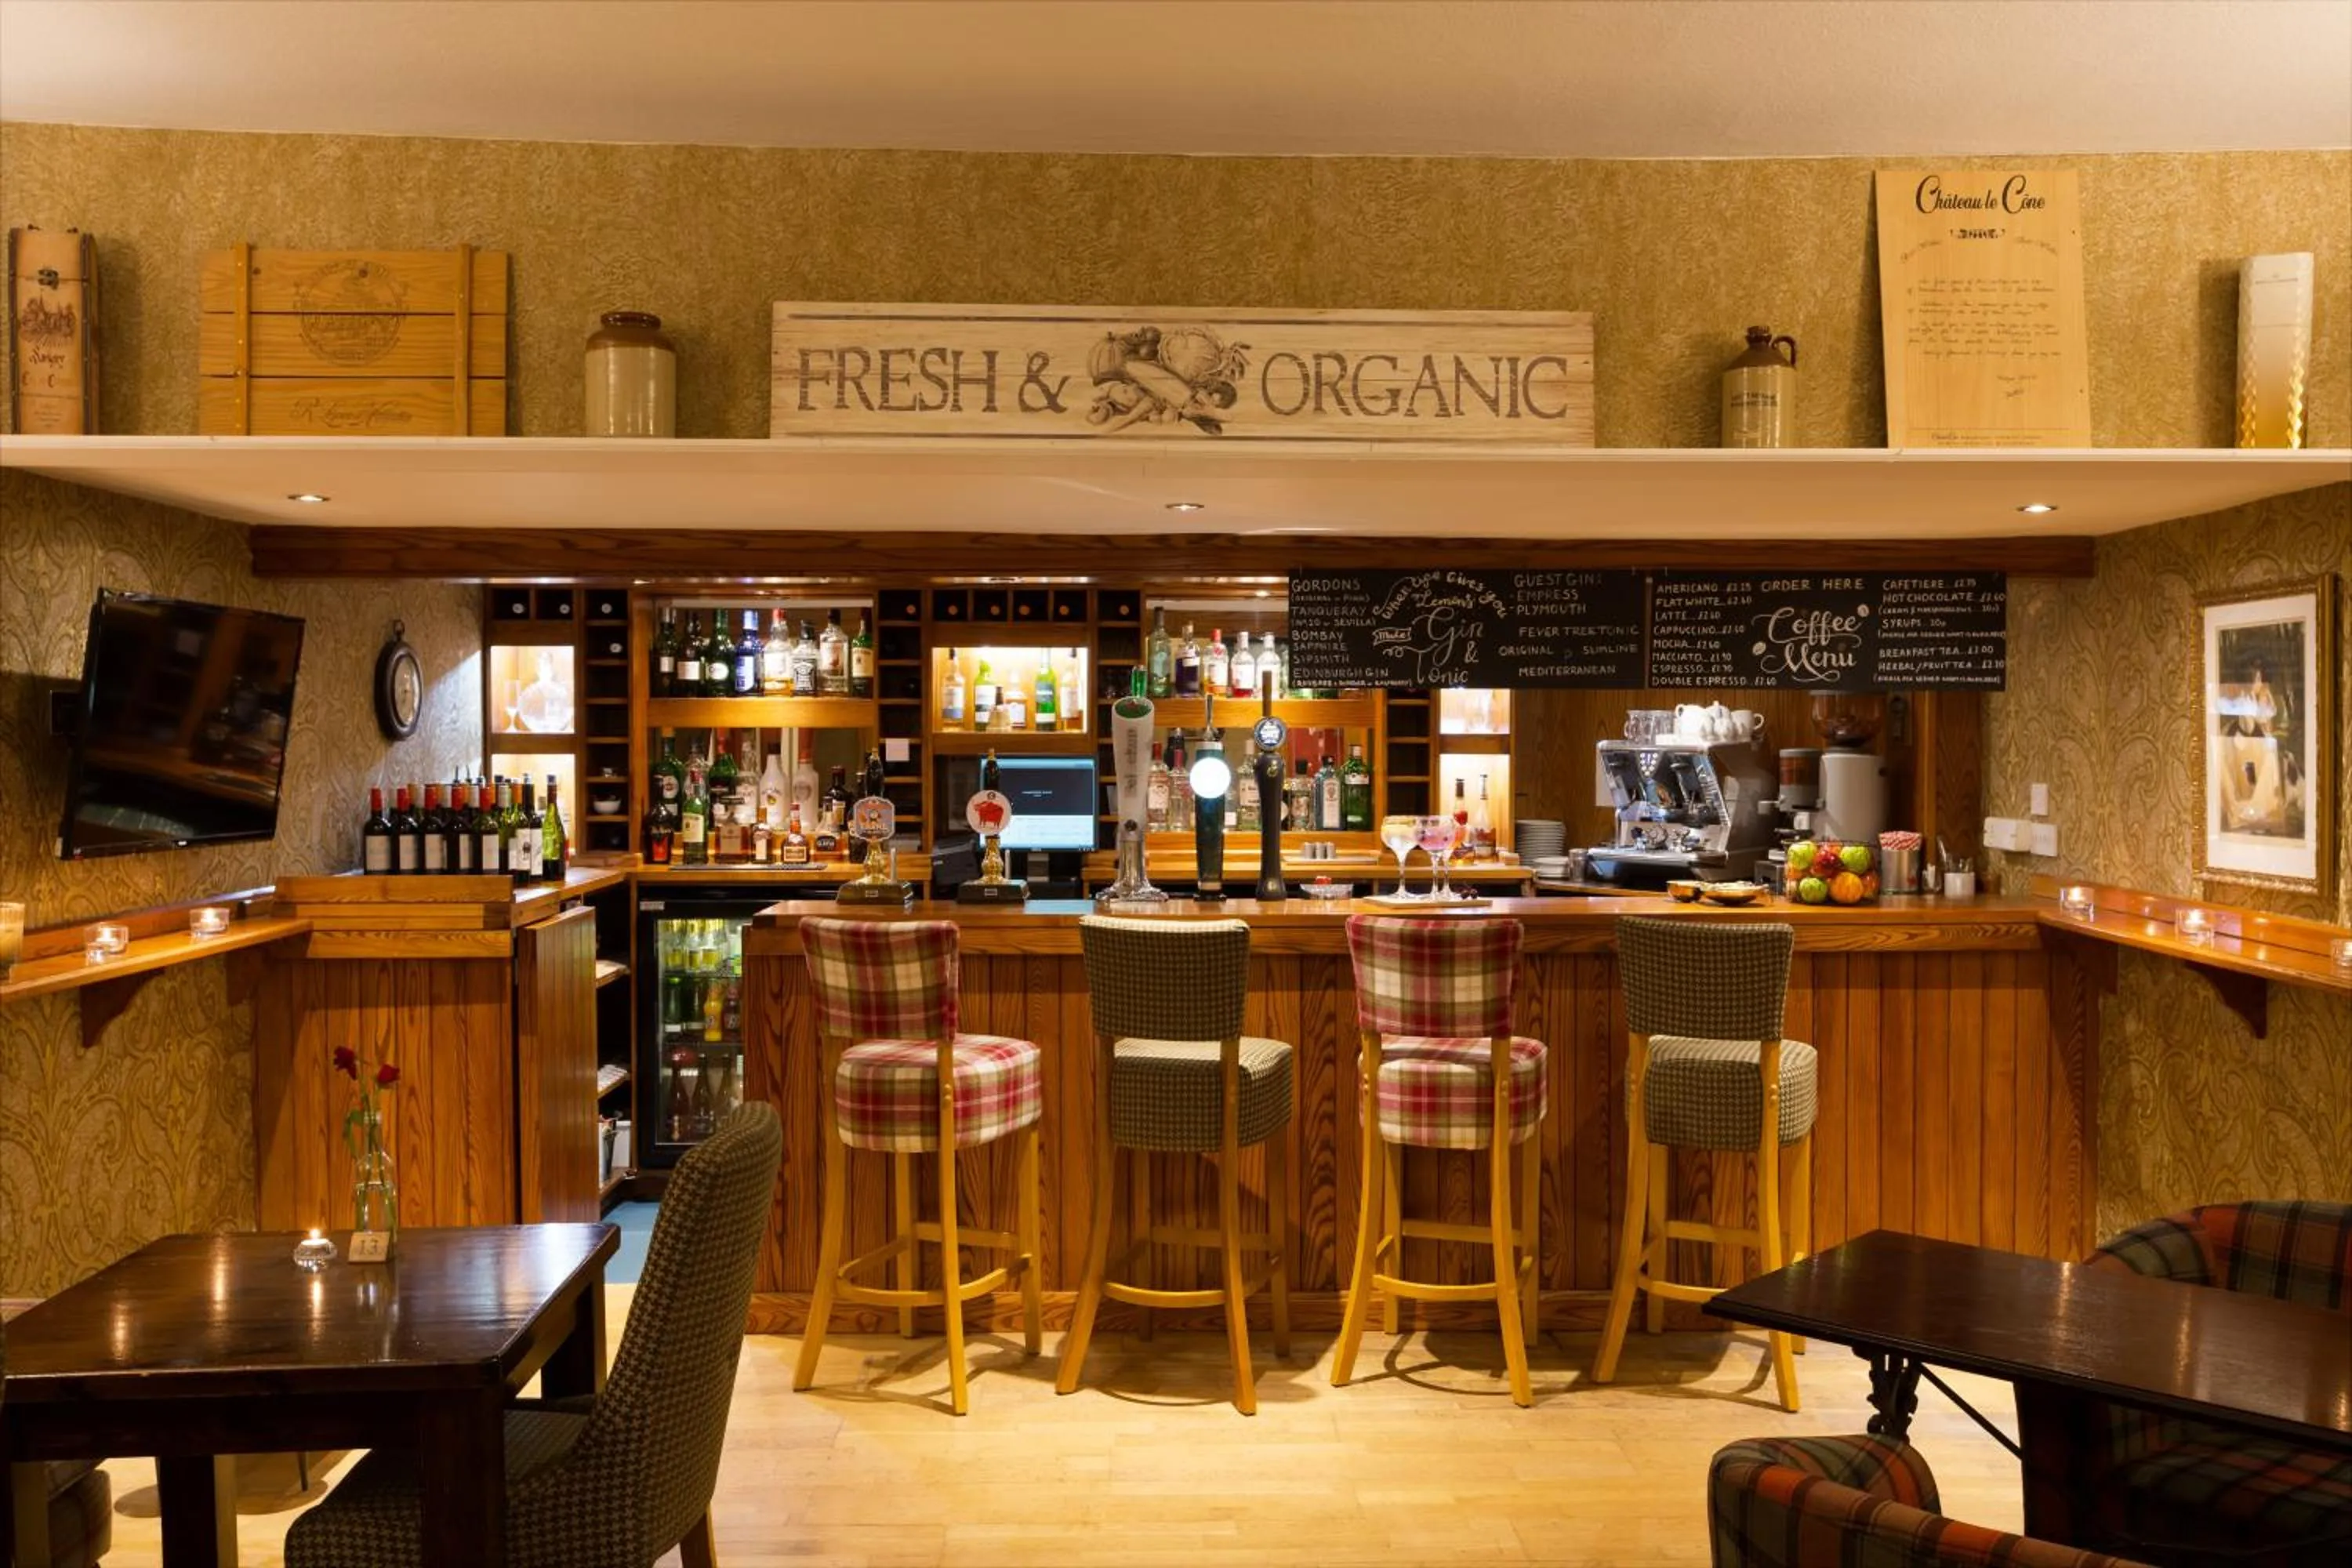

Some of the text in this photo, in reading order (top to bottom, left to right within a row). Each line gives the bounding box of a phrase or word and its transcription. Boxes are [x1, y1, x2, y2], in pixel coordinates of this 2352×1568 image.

[797, 346, 1071, 414] FRESH &
[1261, 351, 1568, 419] ORGANIC
[1291, 579, 1360, 593] GORDONS
[1513, 573, 1563, 588] GUEST
[1761, 578, 1865, 592] ORDER HERE
[1517, 589, 1579, 602] EMPRESS
[1907, 592, 1974, 603] CHOCOLATE
[1517, 602, 1587, 615] PLYMOUTH
[1519, 626, 1560, 637] FEVER
[1759, 607, 1862, 648] Coffee
[1291, 630, 1344, 642] BOMBAY
[1773, 642, 1857, 681] Menu
[1365, 666, 1389, 678] GIN
